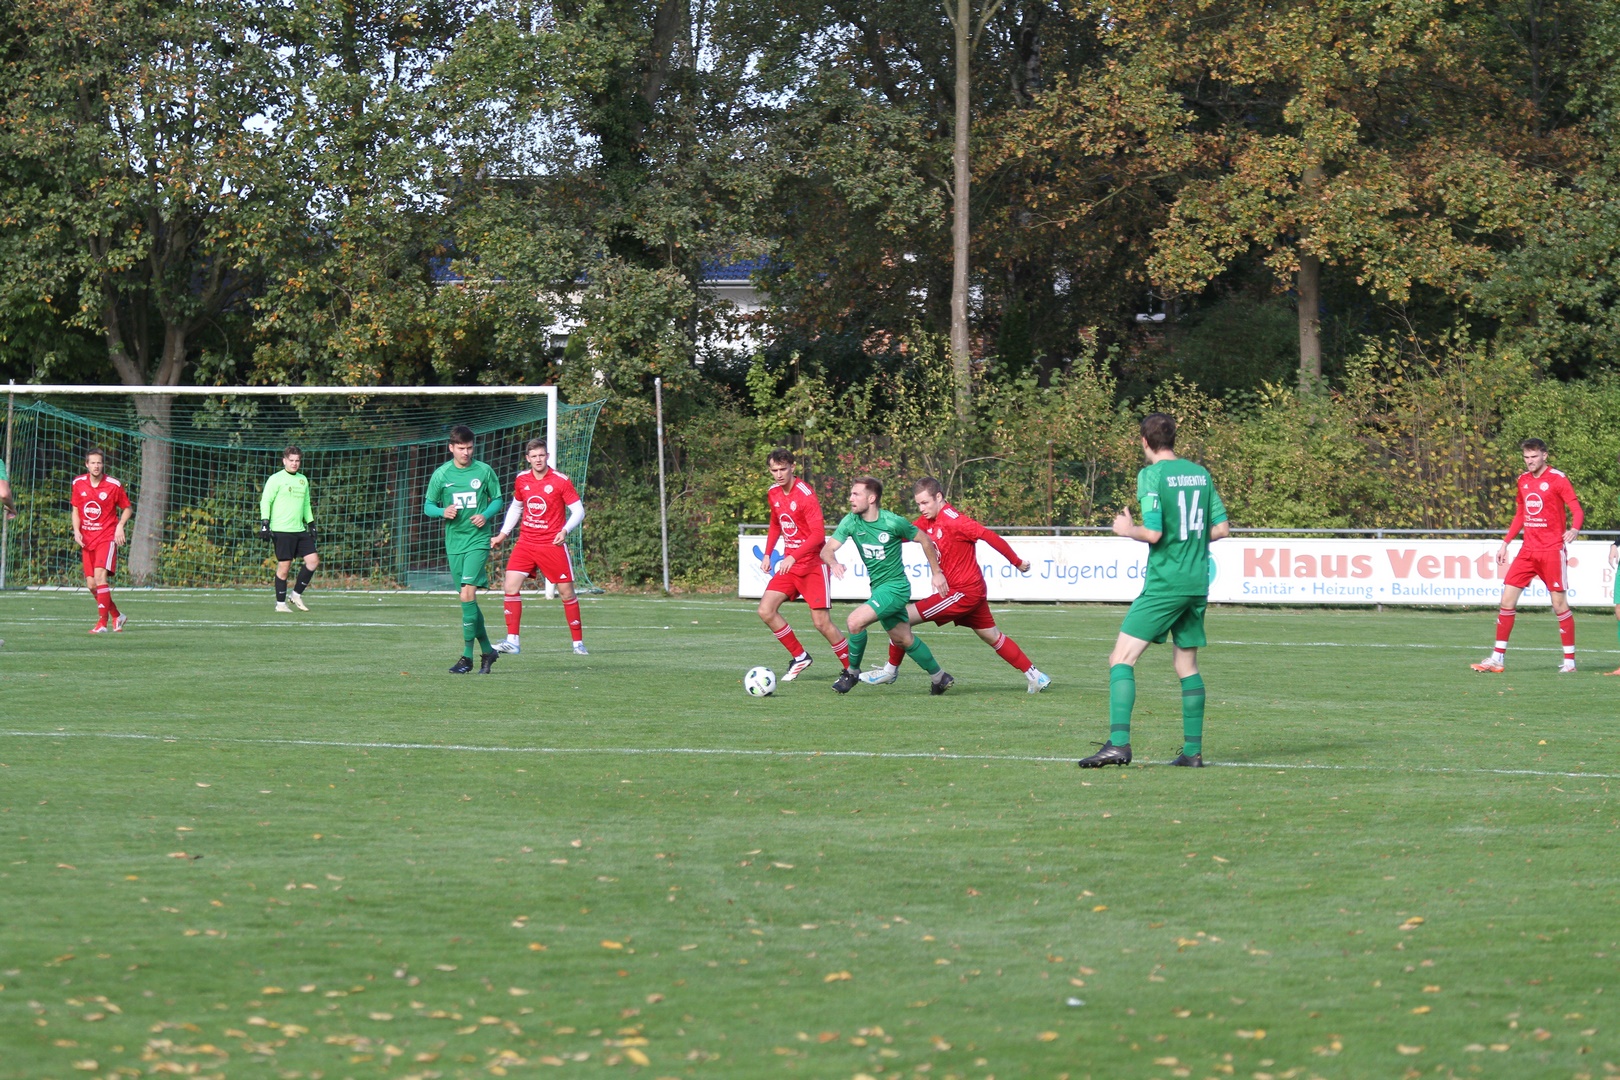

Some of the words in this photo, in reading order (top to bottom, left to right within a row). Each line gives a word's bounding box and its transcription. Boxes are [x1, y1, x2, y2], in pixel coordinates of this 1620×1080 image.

[1167, 476, 1177, 487] SC
[1178, 490, 1204, 540] 14
[1041, 560, 1117, 584] Jugend
[1243, 548, 1373, 579] Klaus
[1243, 582, 1294, 595] Sanitär
[1313, 582, 1373, 599] Heizung
[1392, 583, 1504, 599] Bauklempnerei
